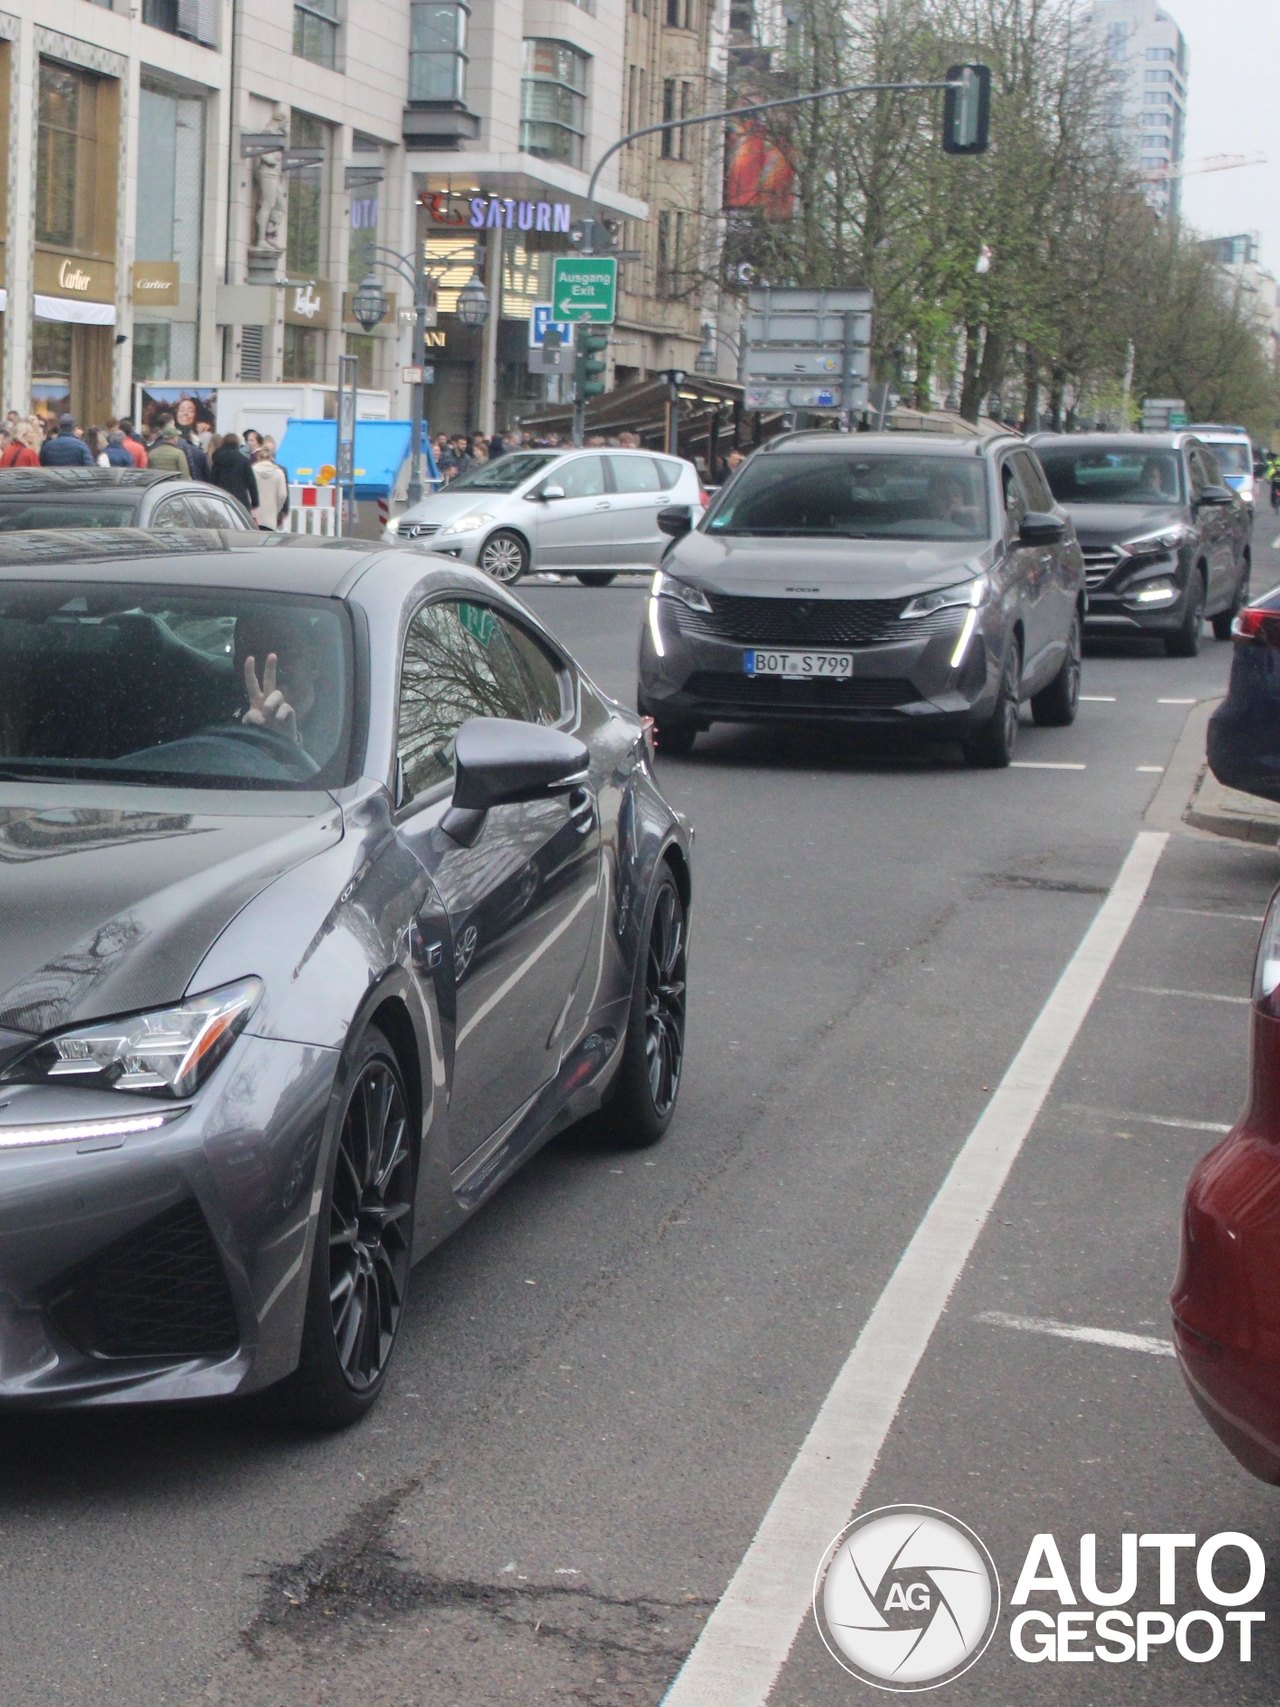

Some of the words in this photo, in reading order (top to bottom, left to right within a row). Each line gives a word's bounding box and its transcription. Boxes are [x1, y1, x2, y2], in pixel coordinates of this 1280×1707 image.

[471, 198, 570, 233] SATURN
[60, 260, 91, 291] Cartier
[559, 272, 612, 286] Ausgang
[136, 279, 173, 290] Cartier
[572, 286, 596, 297] Exit
[756, 654, 789, 671] BOT
[802, 656, 813, 672] S
[817, 656, 850, 673] 799
